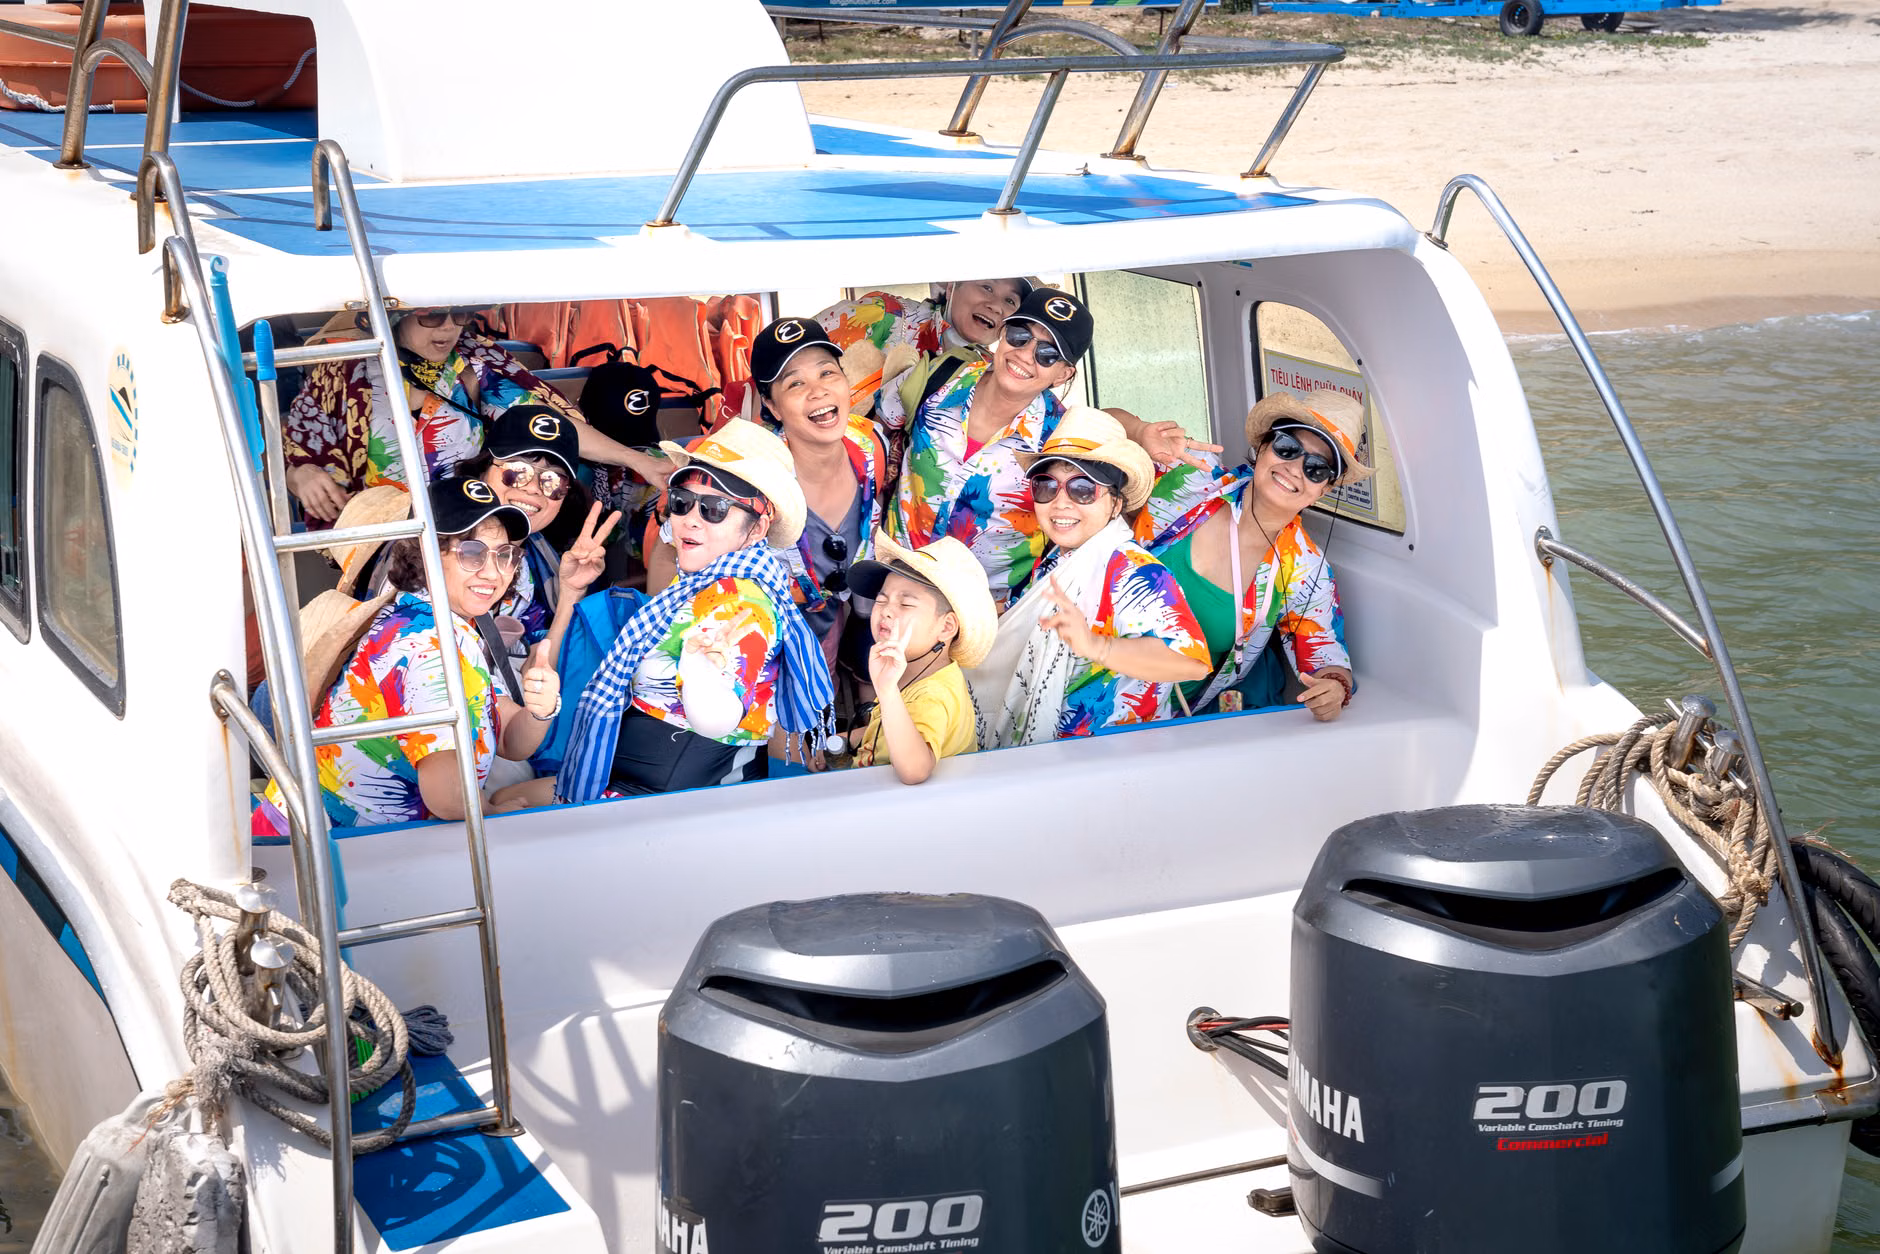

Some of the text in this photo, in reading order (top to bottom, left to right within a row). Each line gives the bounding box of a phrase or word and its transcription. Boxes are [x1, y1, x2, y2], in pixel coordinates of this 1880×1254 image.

[1270, 367, 1289, 387] TIÊU
[1291, 372, 1313, 393] LỆNH
[1473, 1080, 1628, 1120] 200
[1478, 1118, 1624, 1132] Variable Camshaft Timing
[1497, 1131, 1609, 1151] Commercial
[818, 1195, 984, 1243] 200
[823, 1237, 980, 1254] Variable Camshaft Timing
